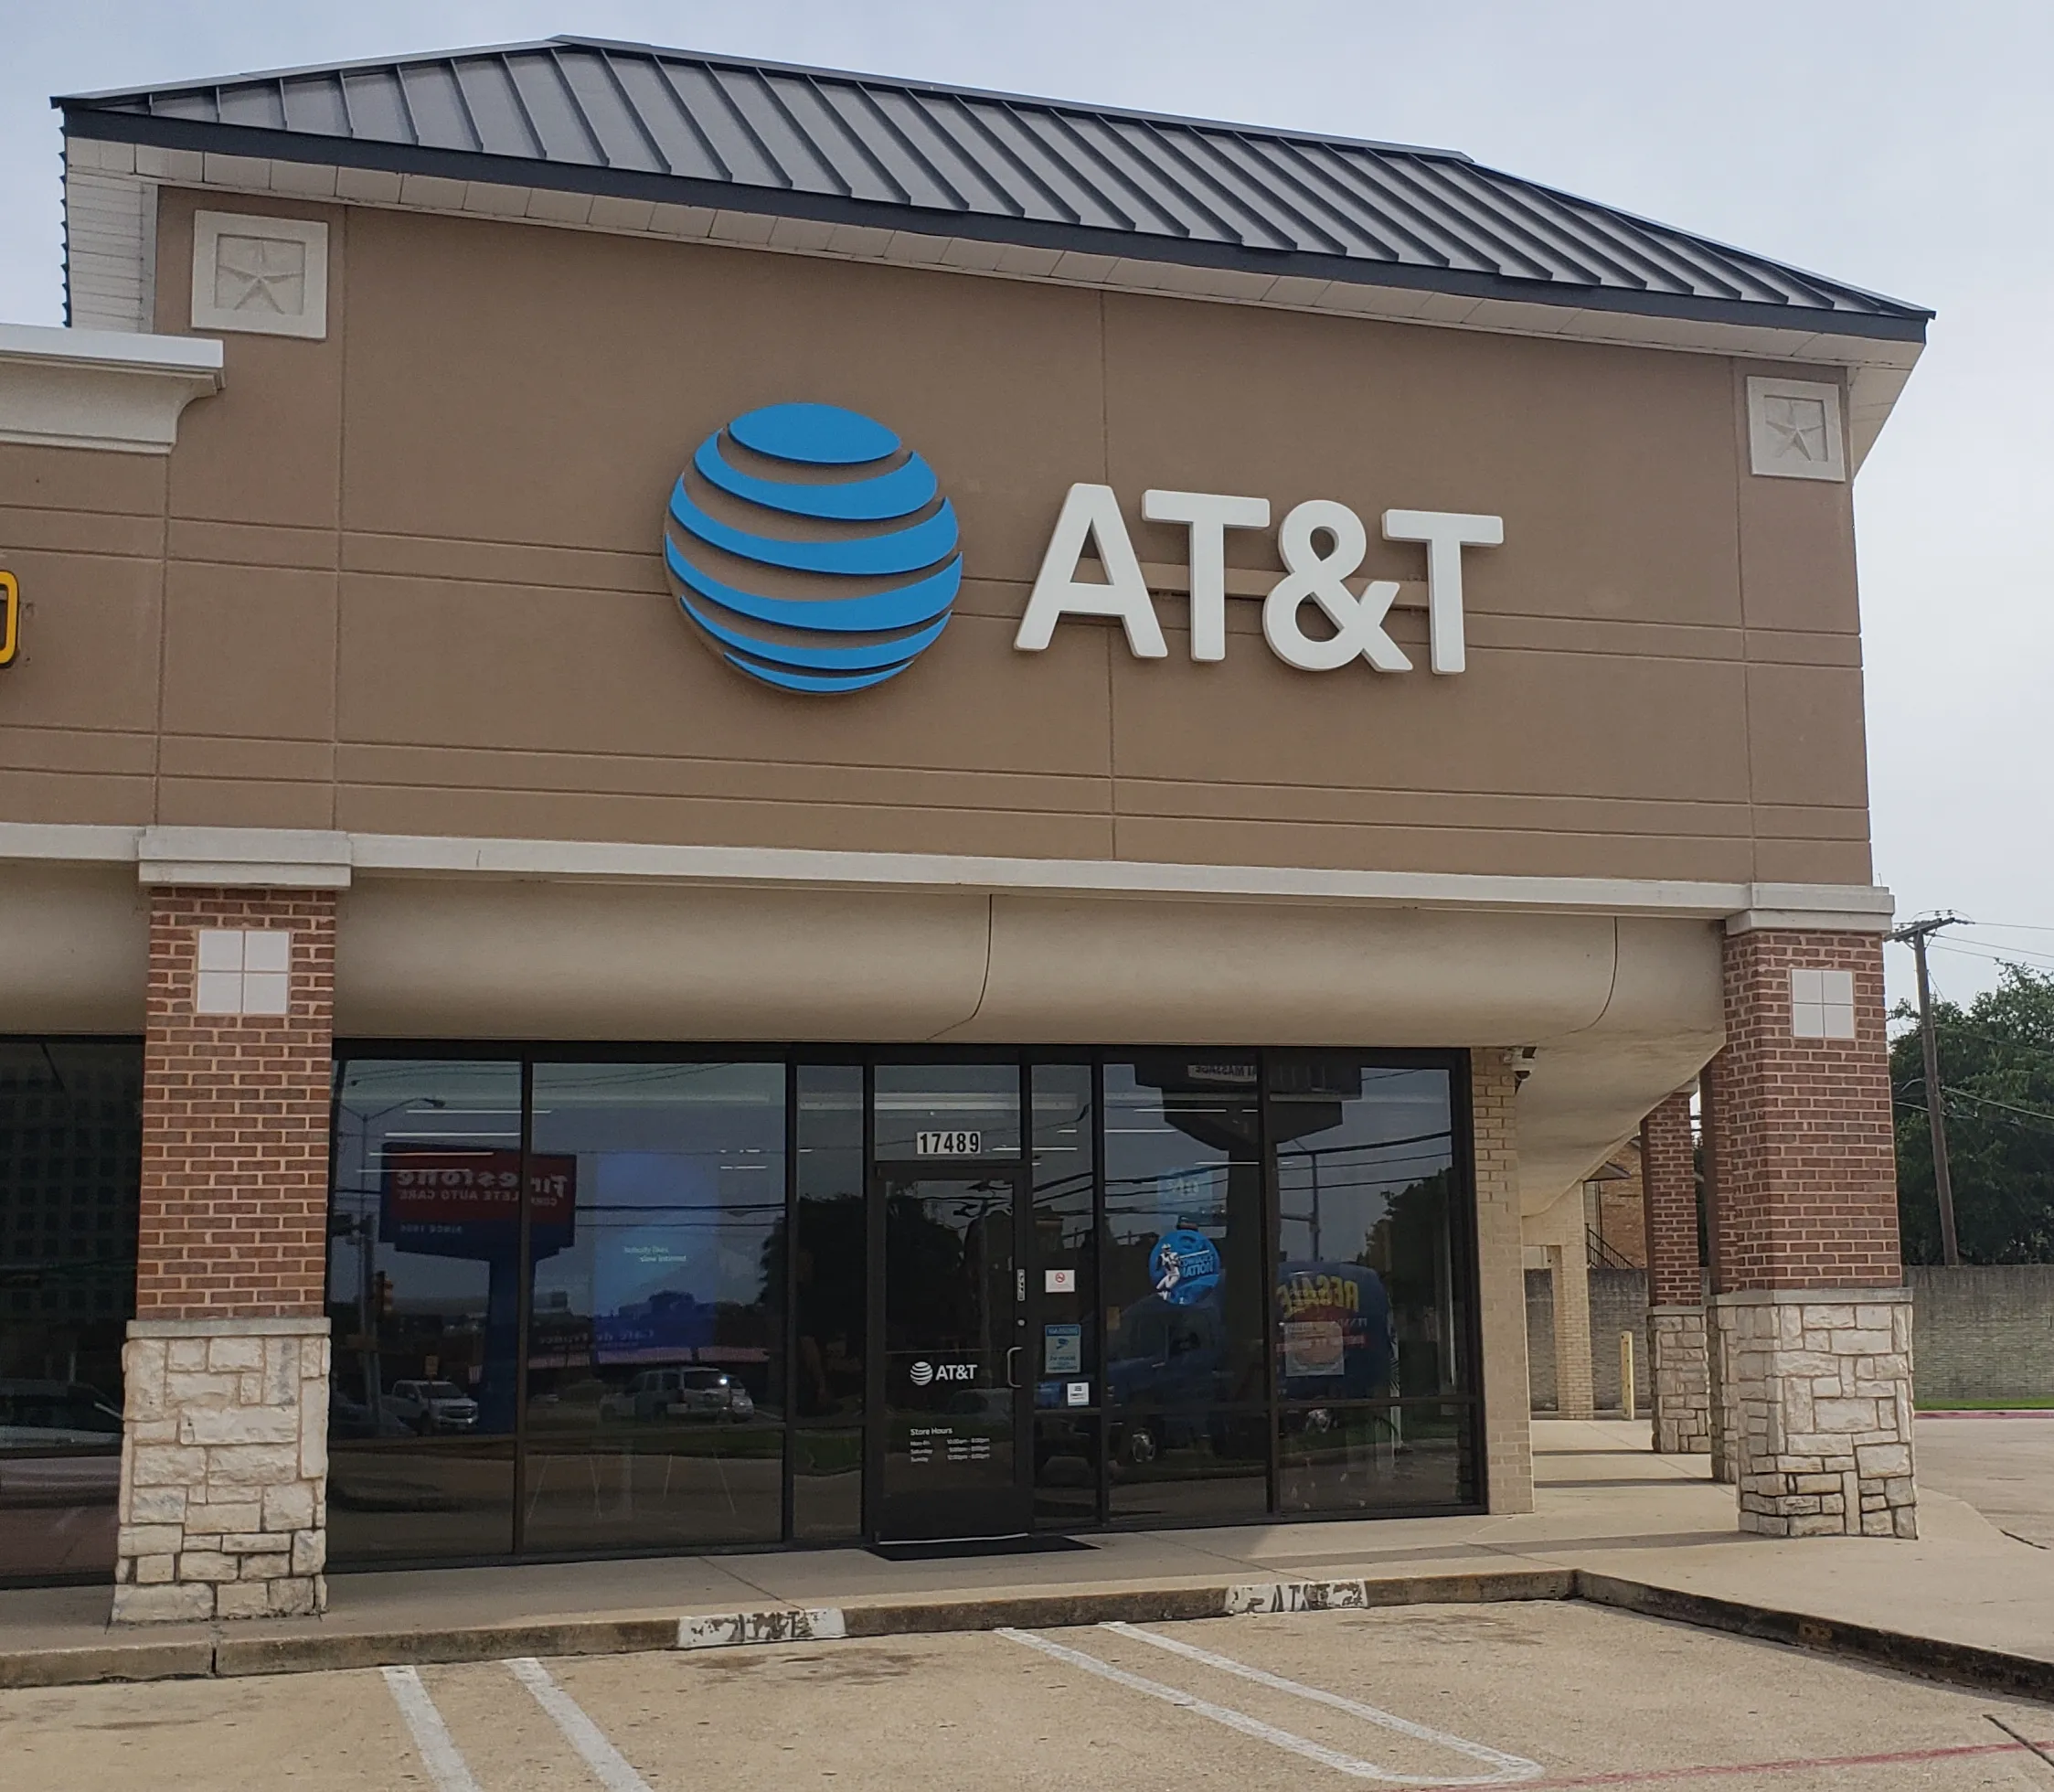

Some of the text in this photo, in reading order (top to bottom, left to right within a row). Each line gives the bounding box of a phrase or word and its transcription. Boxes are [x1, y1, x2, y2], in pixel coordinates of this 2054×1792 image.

[1014, 482, 1504, 675] AT&T
[919, 1132, 981, 1154] 17489
[935, 1363, 978, 1381] AT&T
[910, 1426, 953, 1436] Store Hours
